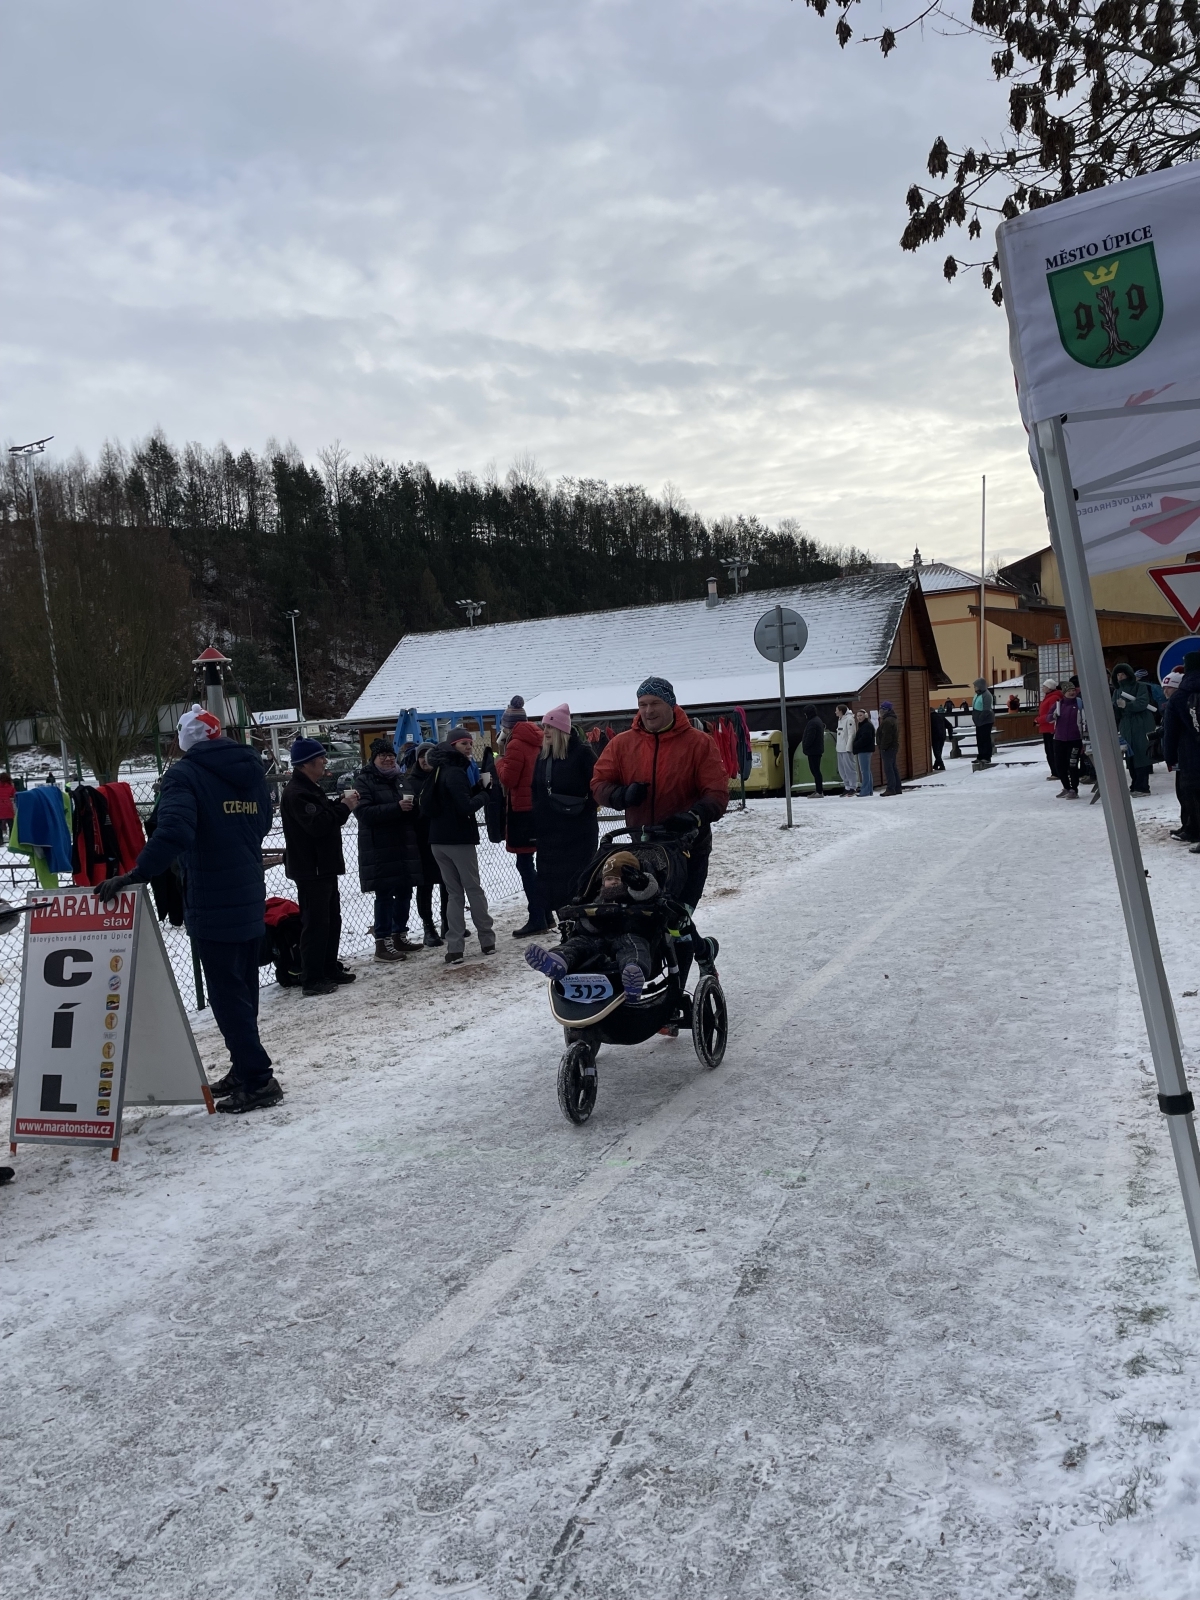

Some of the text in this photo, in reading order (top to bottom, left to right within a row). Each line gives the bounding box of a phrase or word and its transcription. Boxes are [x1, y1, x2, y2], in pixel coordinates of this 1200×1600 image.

[1045, 225, 1153, 270] MĚSTO ÚPICE
[31, 892, 136, 918] MARATON
[103, 916, 130, 927] stav
[80, 934, 108, 942] jednota
[570, 984, 607, 999] 312
[19, 1121, 111, 1135] www.maratonstav.cz
